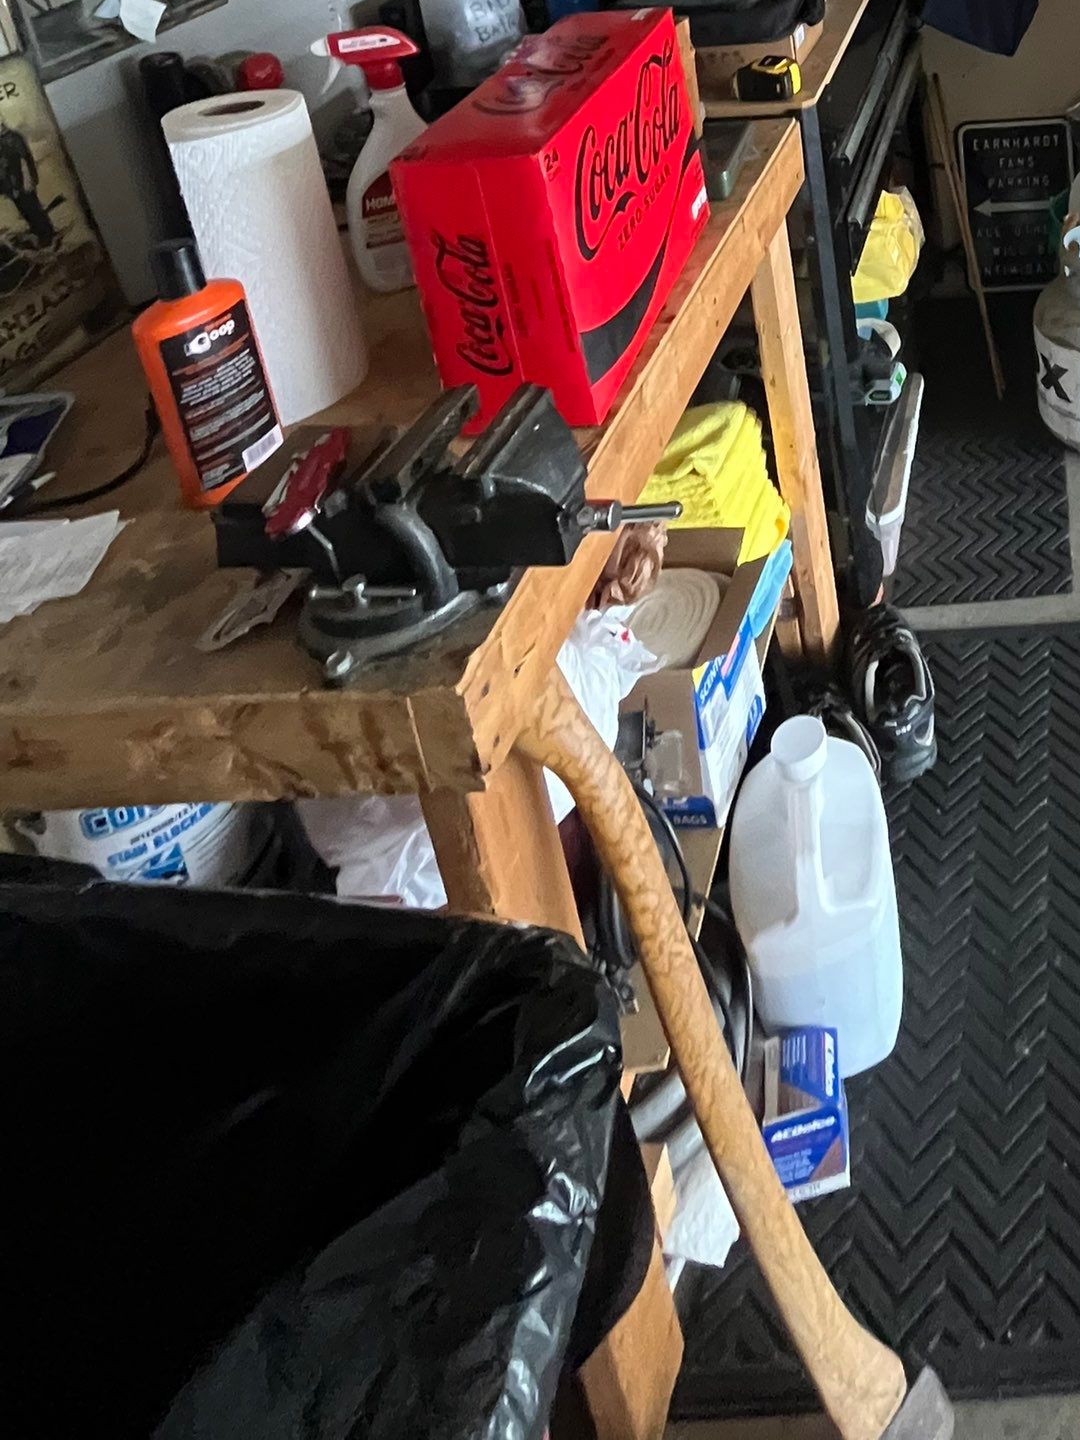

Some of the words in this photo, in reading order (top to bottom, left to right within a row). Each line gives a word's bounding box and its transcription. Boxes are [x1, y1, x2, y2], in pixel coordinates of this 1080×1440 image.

[574, 38, 681, 262] Coca-Cola
[973, 134, 1060, 152] EARNHARDT
[999, 157, 1035, 169] FANS
[988, 174, 1050, 190] PARKING
[616, 209, 643, 250] ZERO
[643, 164, 671, 211] SUGAR
